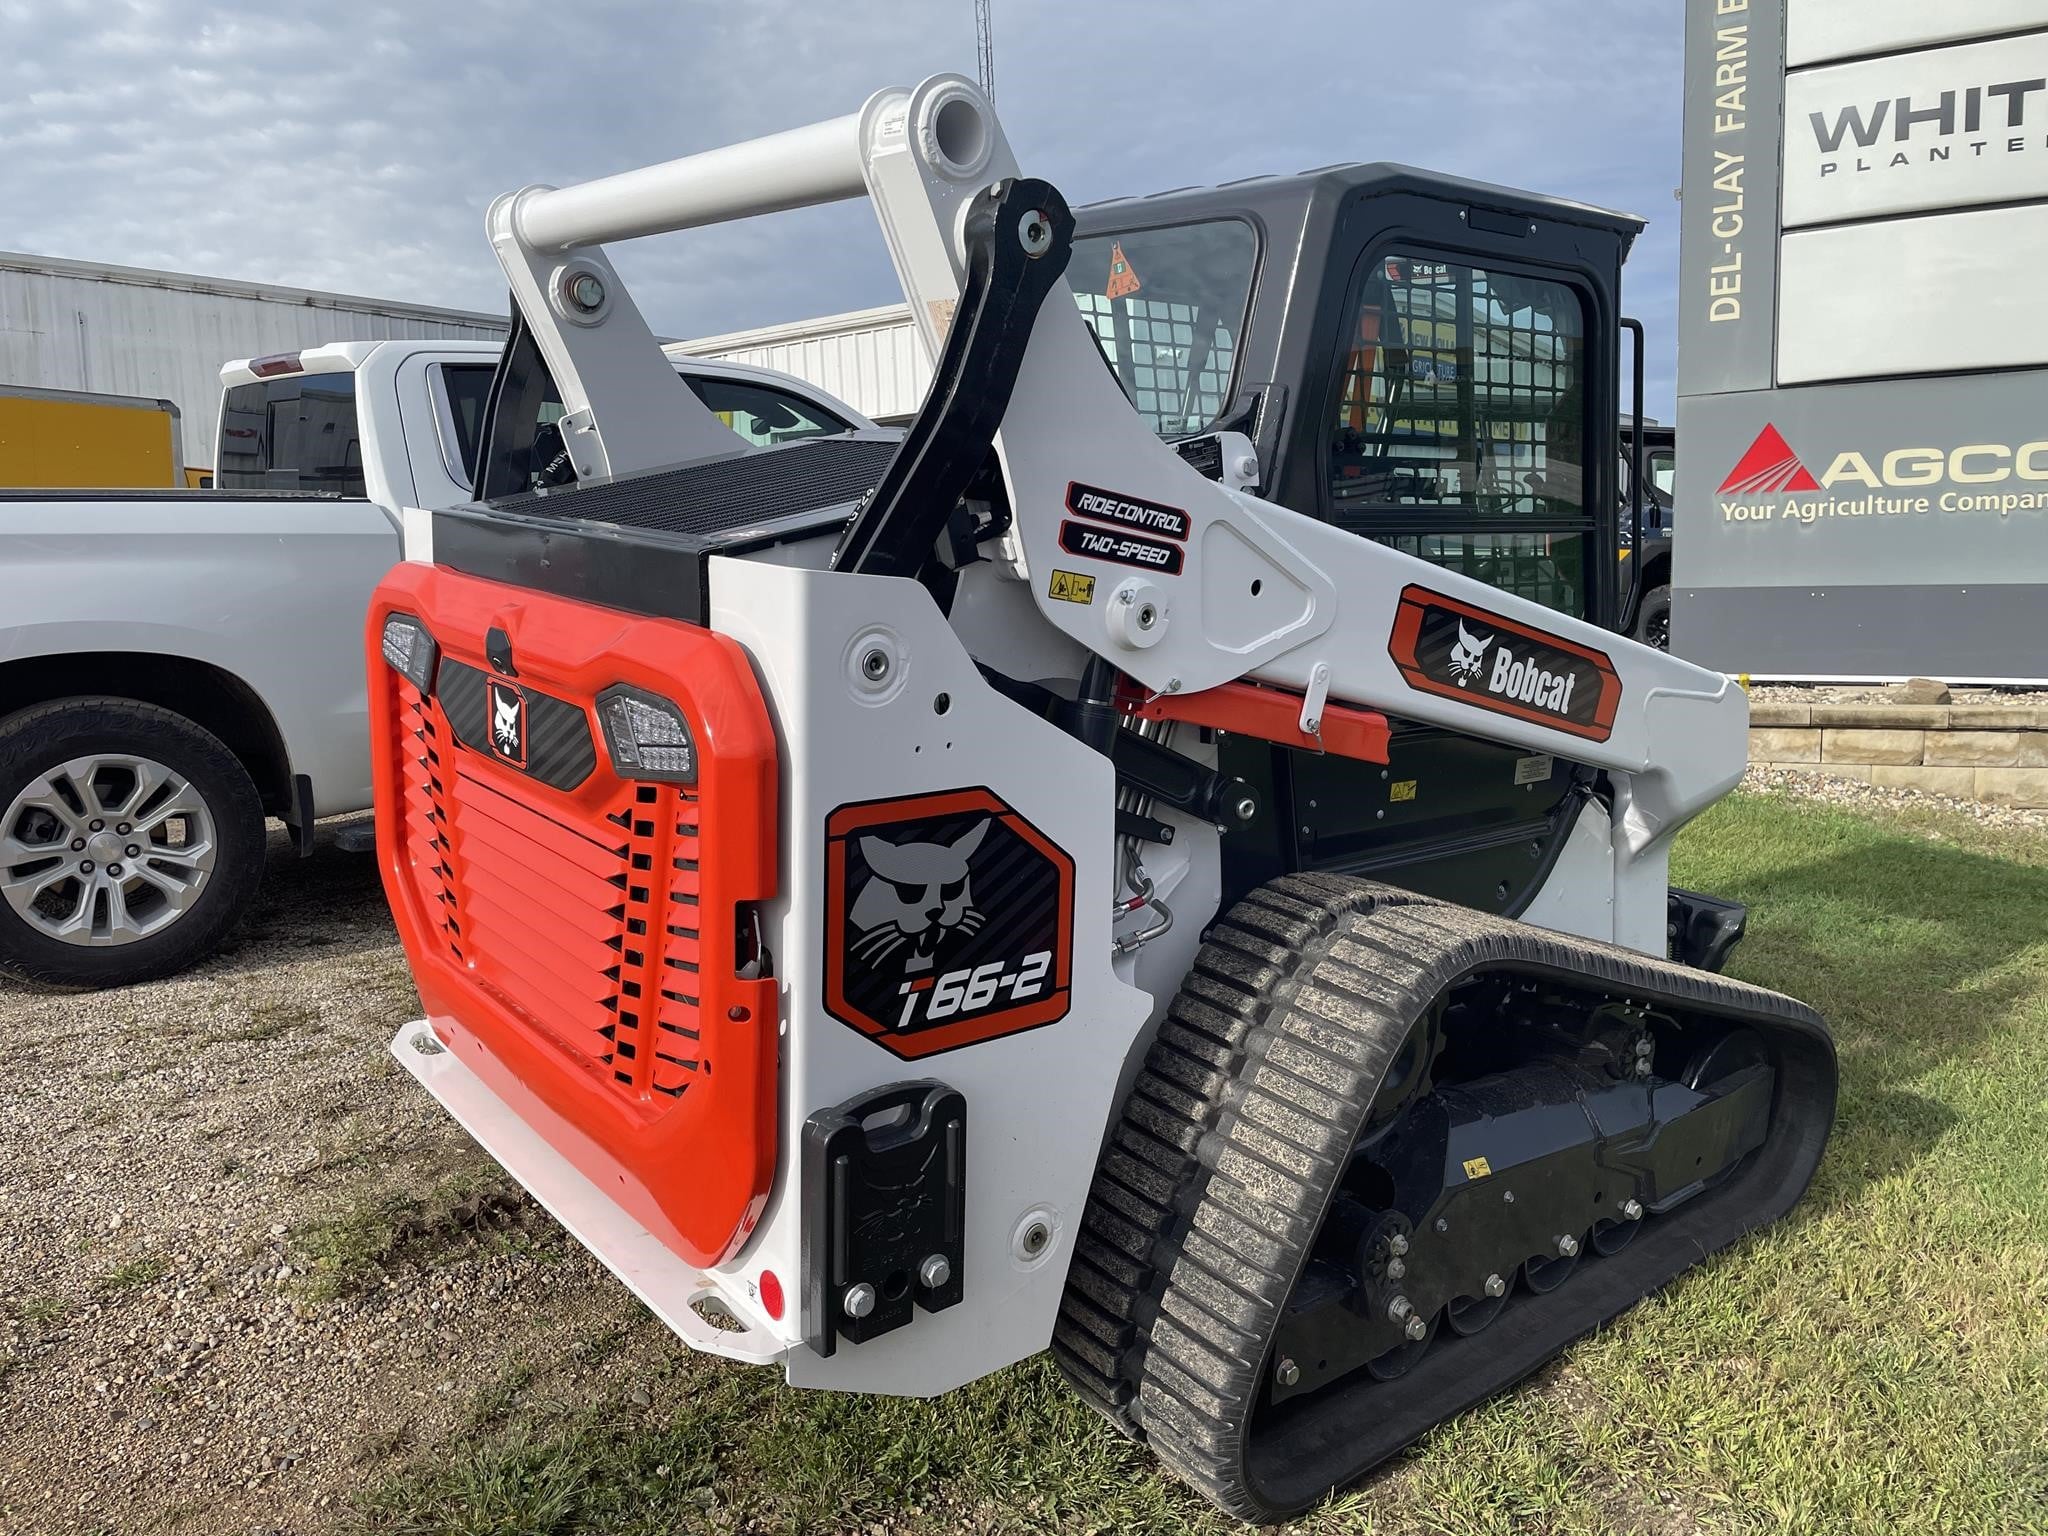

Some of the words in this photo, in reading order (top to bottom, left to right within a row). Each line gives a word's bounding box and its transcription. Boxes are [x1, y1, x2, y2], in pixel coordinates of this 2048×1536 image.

[1714, 25, 1748, 135] FARM
[1820, 134, 2048, 177] PLANTE
[1709, 149, 1745, 322] DEL-CLAY
[1423, 264, 1447, 275] Bocat
[1077, 493, 1117, 516] RIDE
[1114, 502, 1182, 533] CONTROL
[1721, 501, 1776, 522] Your
[1782, 494, 1929, 523] Agriculture
[1082, 533, 1170, 565] TWO-SPEED
[1489, 647, 1575, 714] Bobcat
[896, 950, 1052, 1028] T66-2
